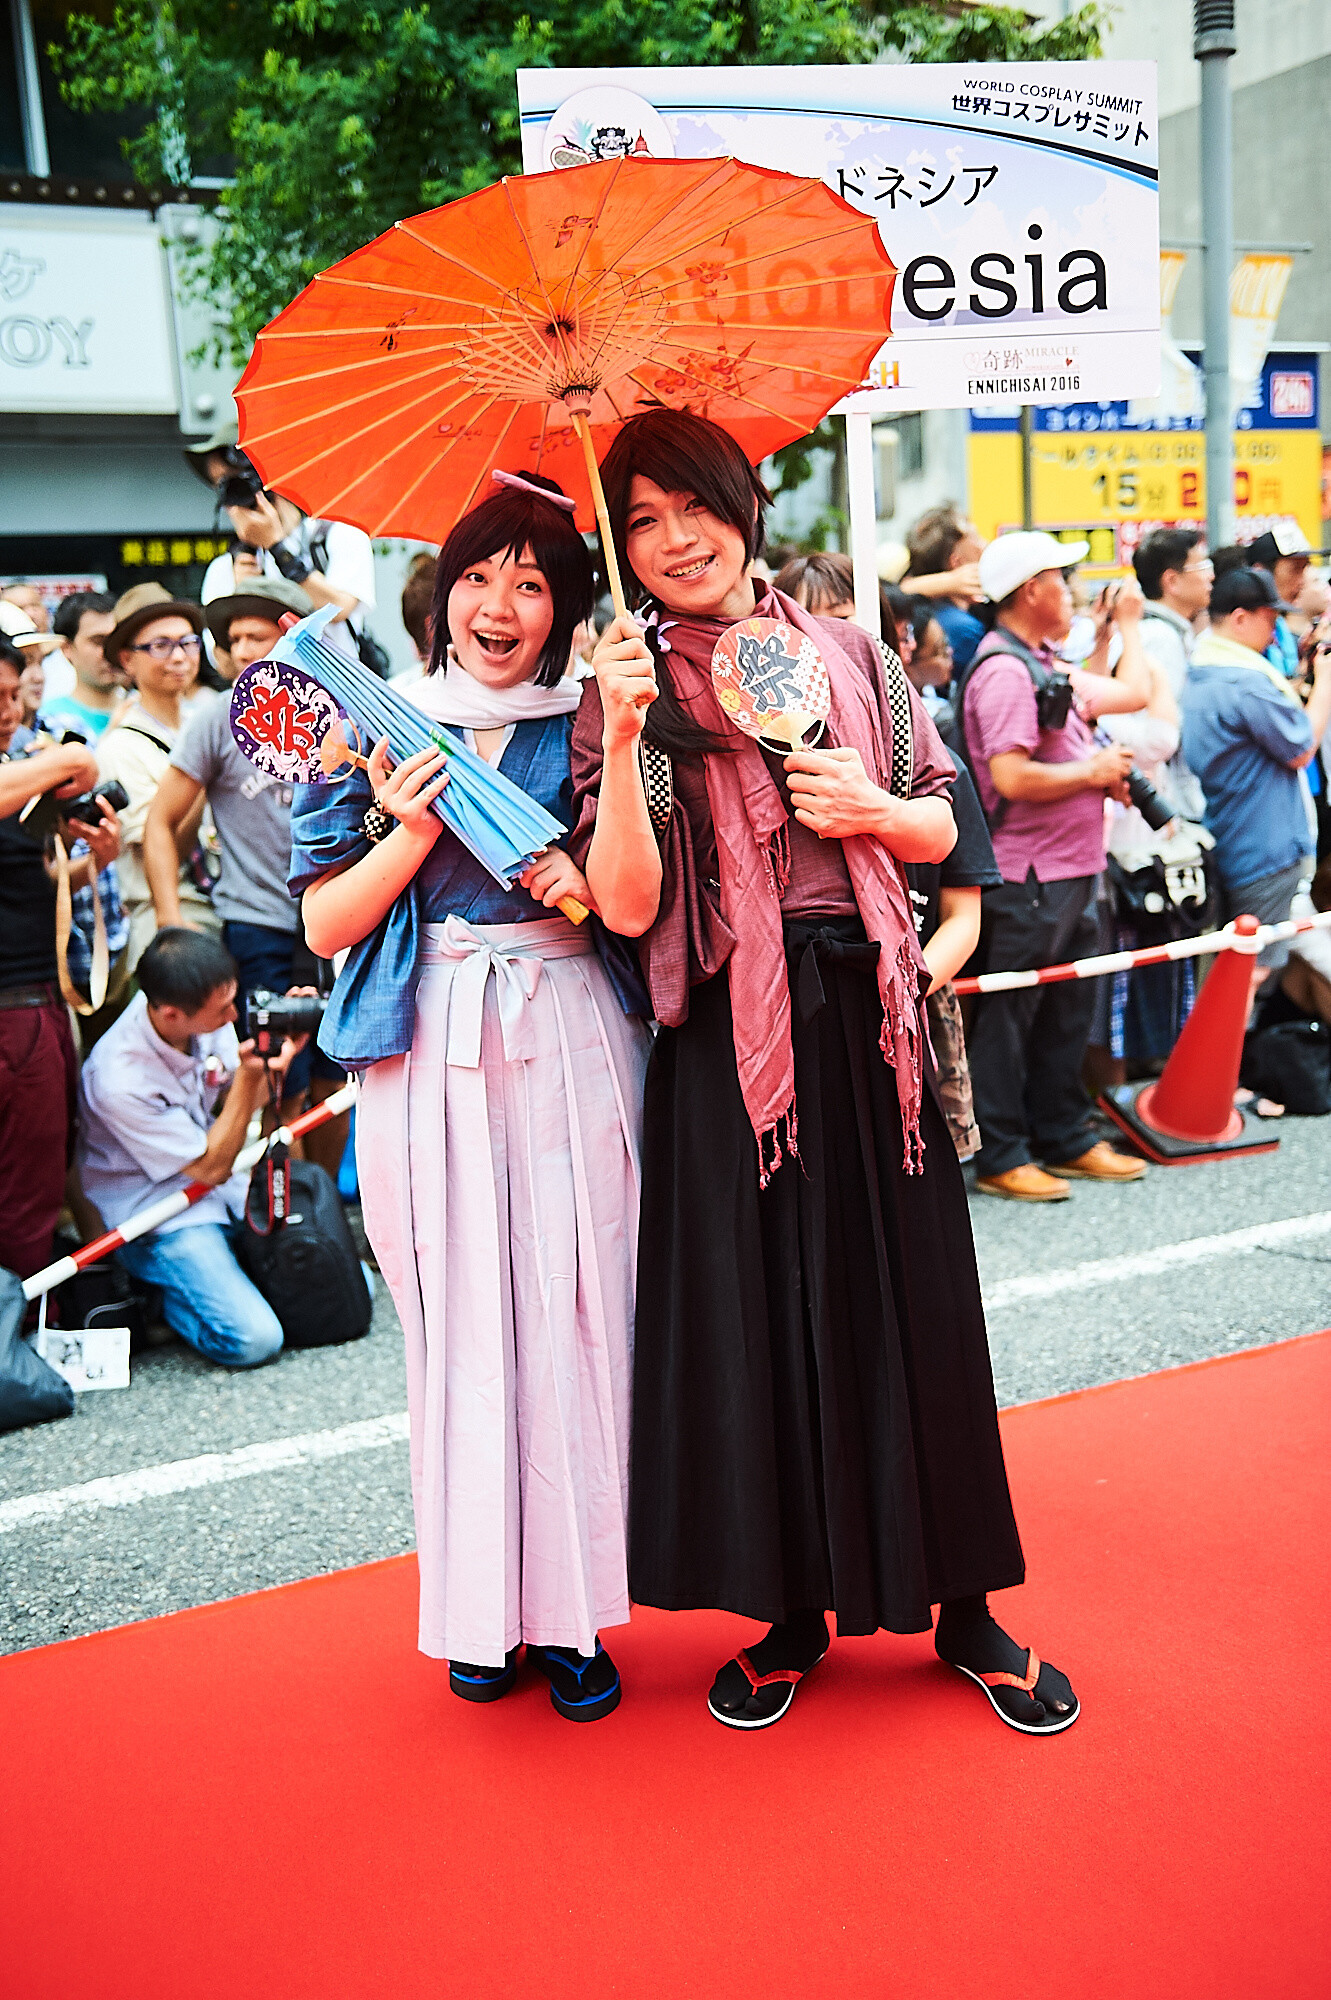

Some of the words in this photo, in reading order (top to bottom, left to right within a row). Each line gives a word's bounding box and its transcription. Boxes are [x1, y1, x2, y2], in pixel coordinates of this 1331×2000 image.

[963, 79, 1015, 93] WORLD
[1020, 84, 1083, 103] COSPLAY
[1087, 92, 1143, 115] SUMMIT
[952, 95, 1149, 146] 世界コスプレサミット
[836, 165, 999, 209] ドネシア
[1025, 346, 1079, 357] MIRACLE
[968, 377, 1046, 394] ENNICHISAI
[1050, 375, 1080, 391] 2016
